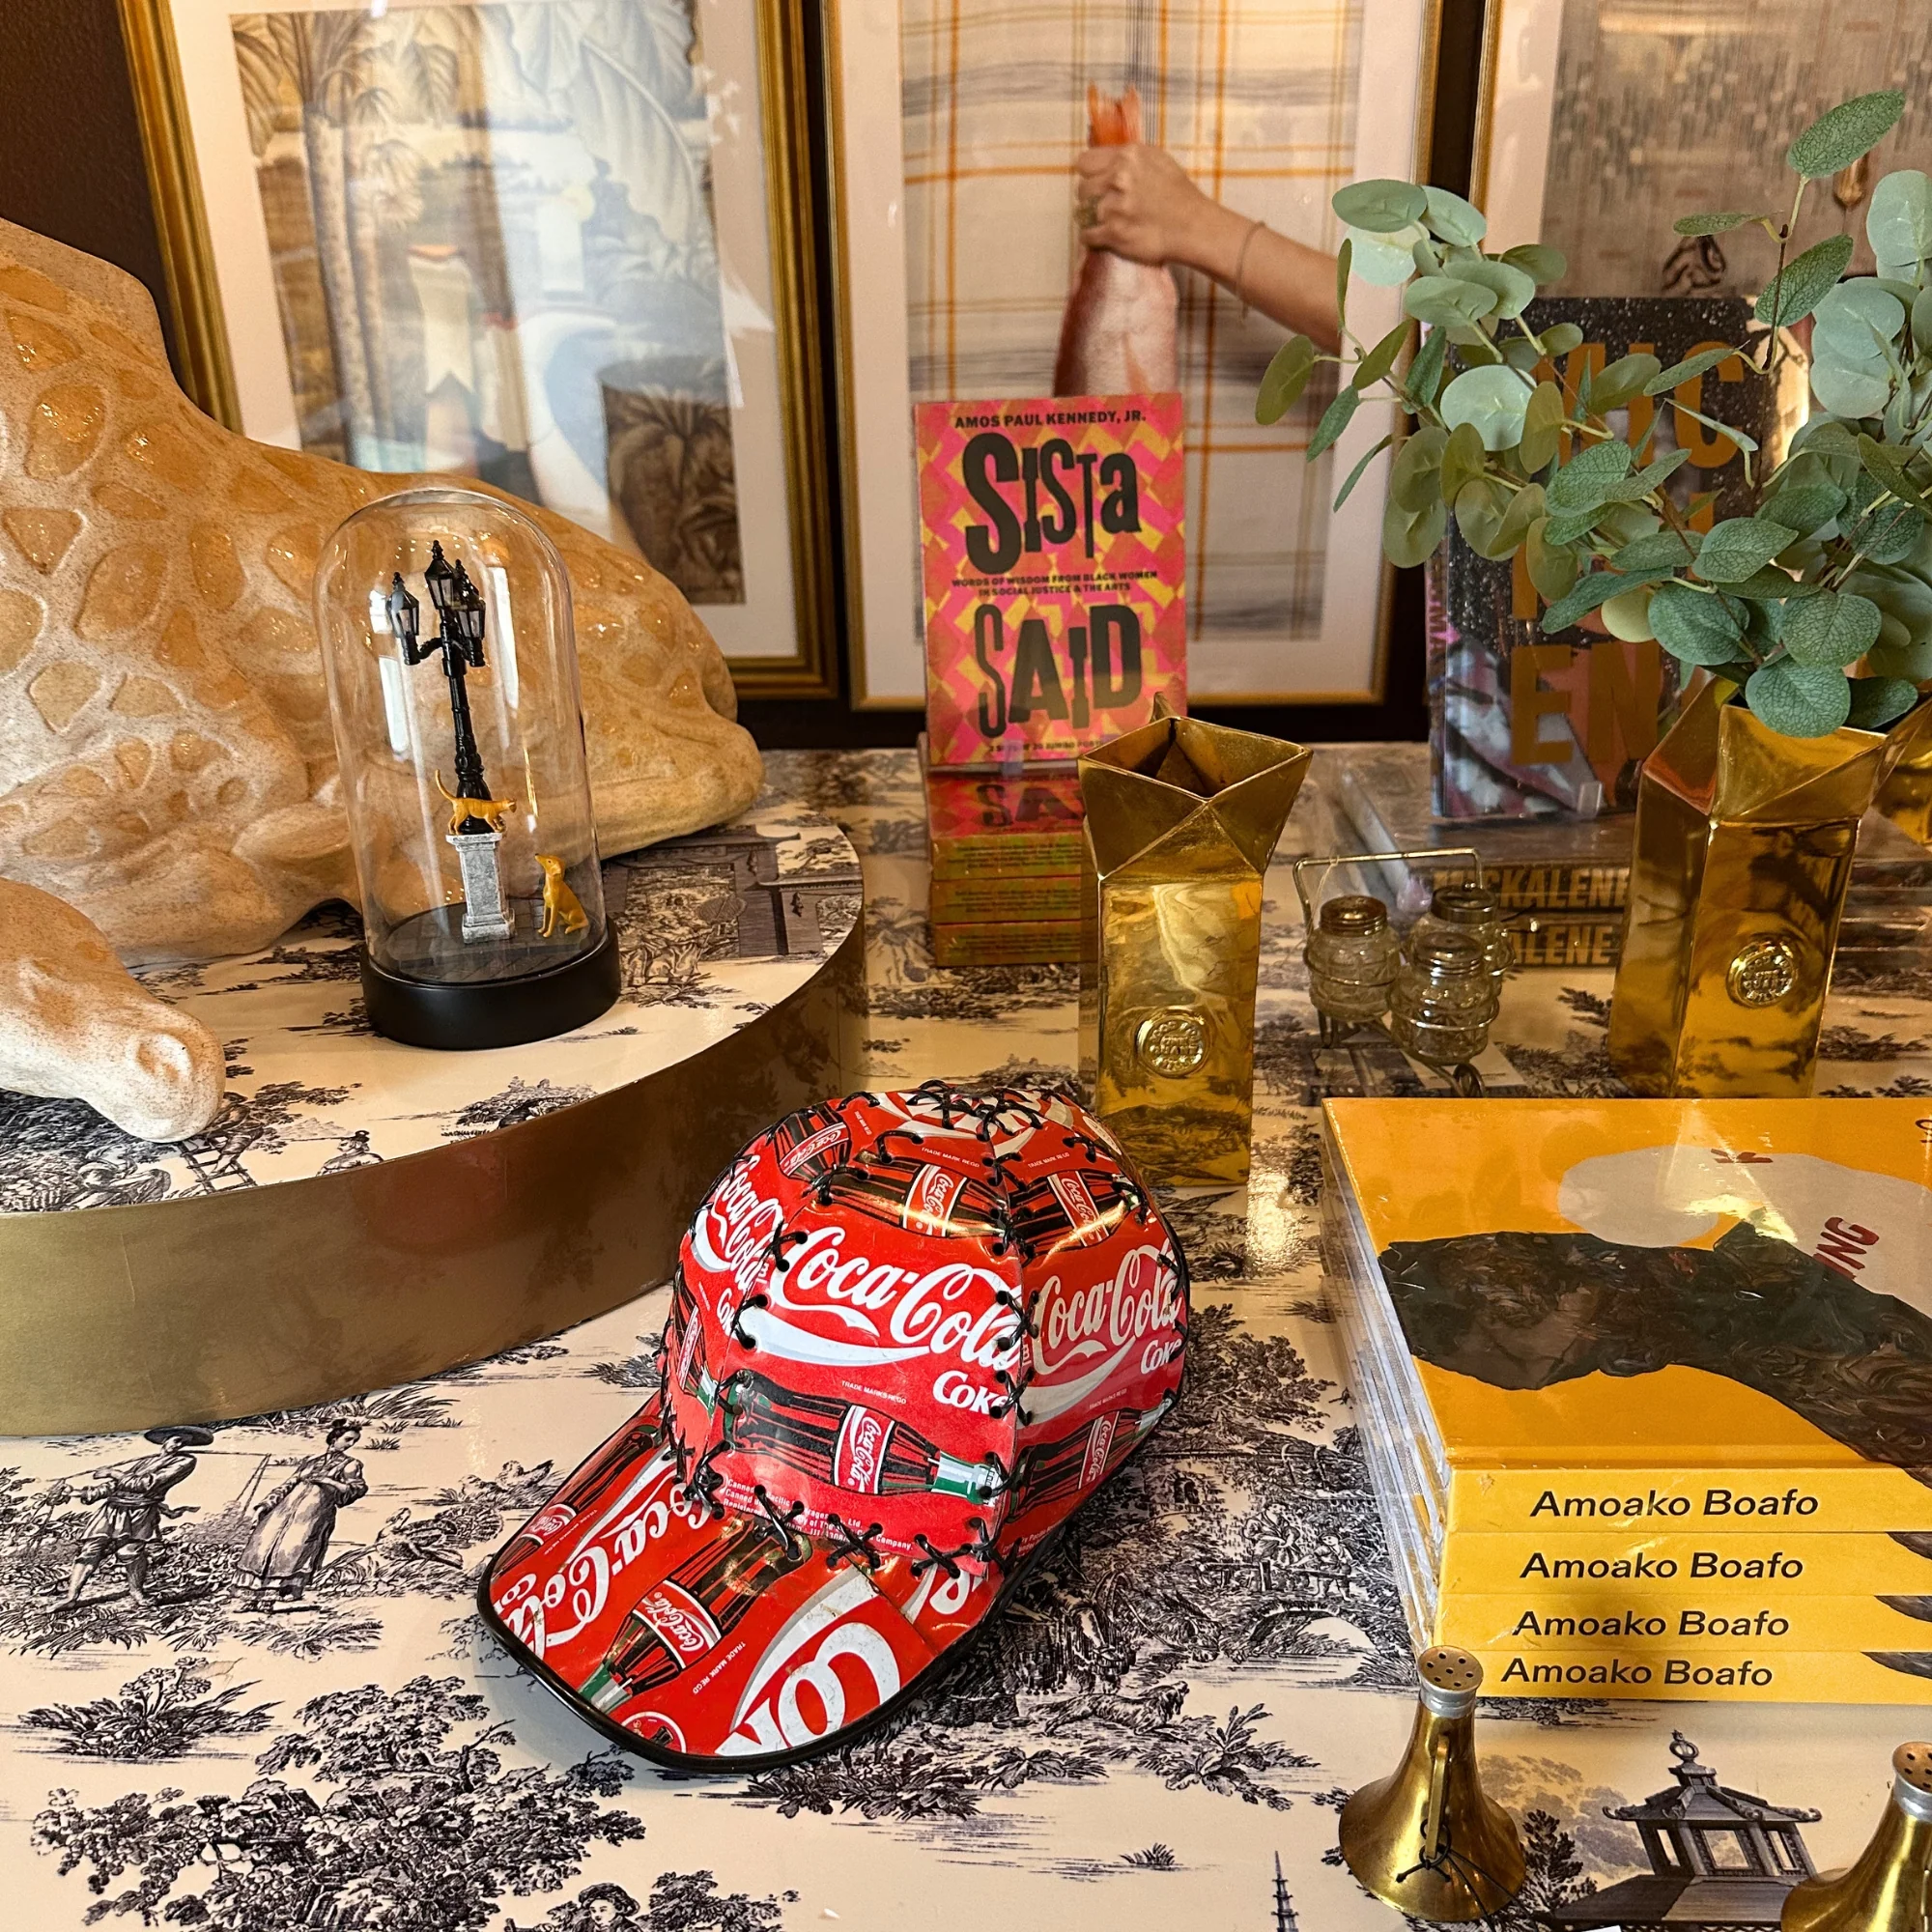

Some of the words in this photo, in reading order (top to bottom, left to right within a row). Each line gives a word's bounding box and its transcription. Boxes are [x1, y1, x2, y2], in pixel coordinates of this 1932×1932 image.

[954, 415, 1000, 429] AMOS
[1004, 412, 1042, 427] PAUL
[1045, 411, 1121, 425] KENNEDY,
[1123, 410, 1147, 422] JR.
[952, 578, 989, 587] WORDS
[991, 577, 1004, 586] OF
[1052, 574, 1080, 583] FROM
[1083, 572, 1115, 582] BLACK
[1119, 570, 1157, 580] WOMEN
[975, 603, 1142, 739] SAID
[770, 1226, 1022, 1372] Coca-Cola
[841, 1379, 863, 1392] TRADE
[1530, 1489, 1690, 1518] Amoako
[1703, 1489, 1819, 1517] Boafo
[1520, 1552, 1678, 1578] Amoako
[1690, 1552, 1804, 1578] Boafo
[1512, 1610, 1666, 1636] Amoako
[1678, 1610, 1790, 1636] Boafo
[725, 1641, 746, 1662] TRADE
[709, 1659, 727, 1678] MARK
[1500, 1658, 1652, 1683] Amoako
[1663, 1660, 1774, 1686] Boafo
